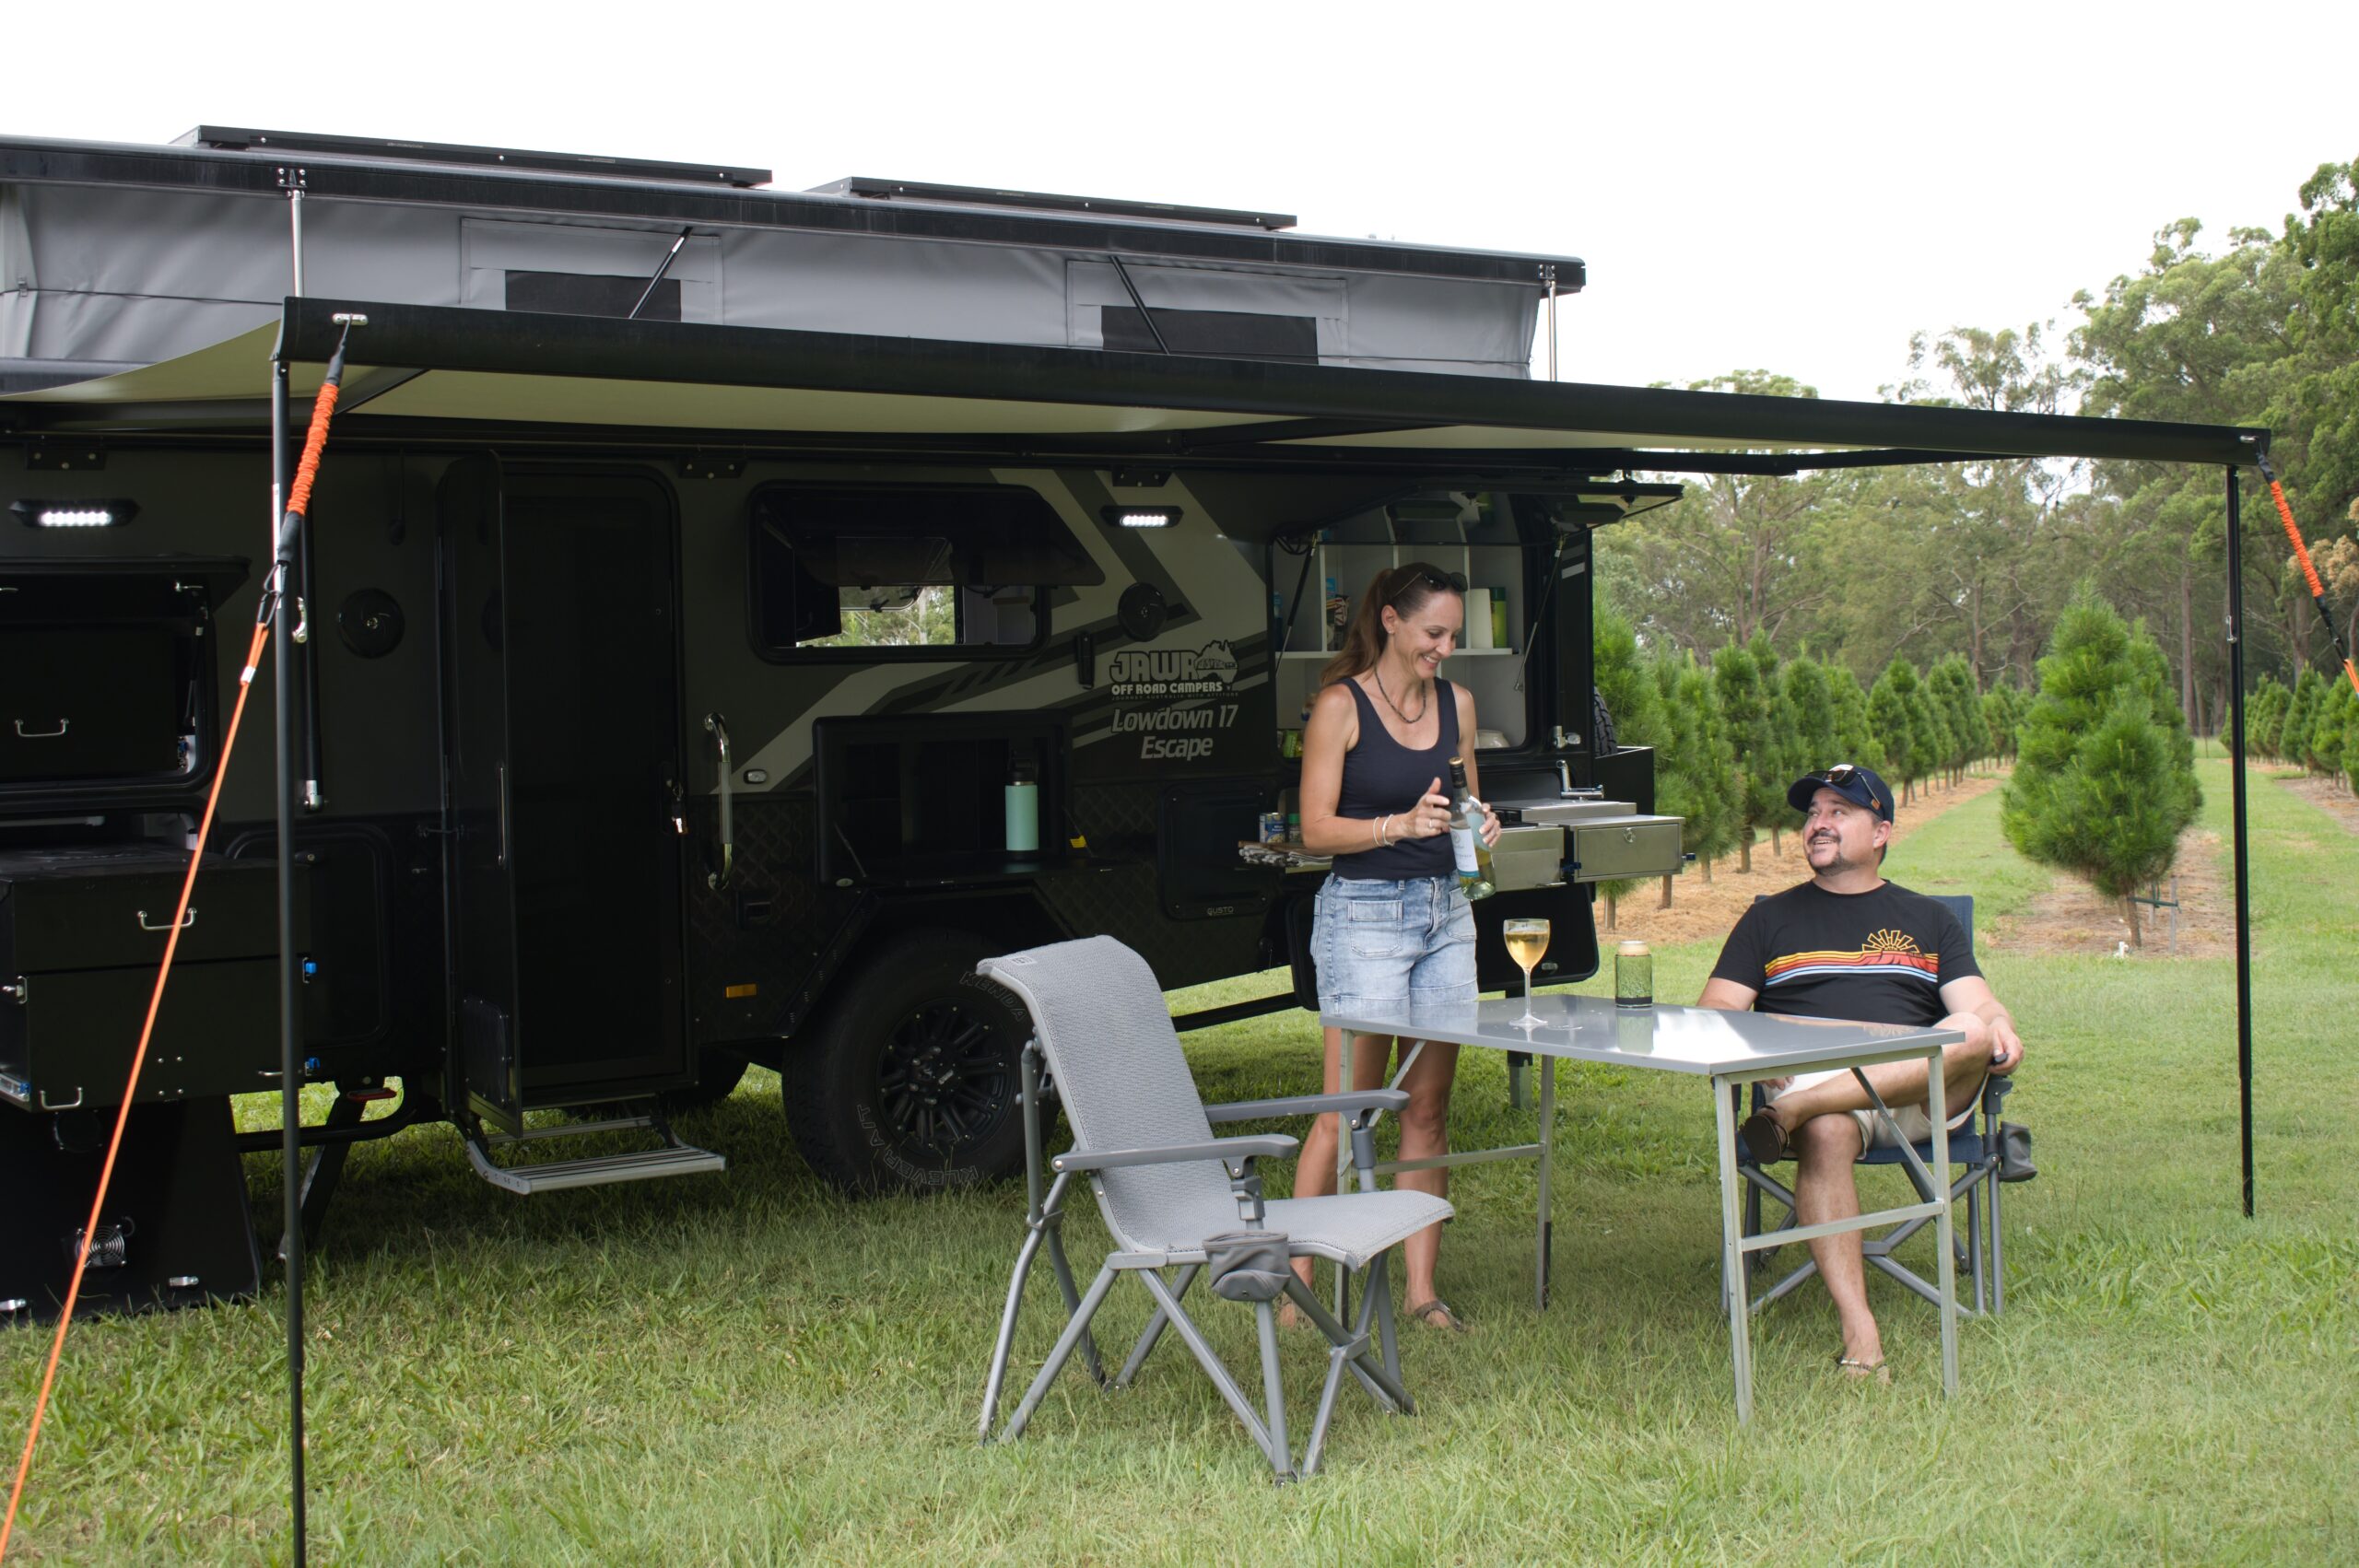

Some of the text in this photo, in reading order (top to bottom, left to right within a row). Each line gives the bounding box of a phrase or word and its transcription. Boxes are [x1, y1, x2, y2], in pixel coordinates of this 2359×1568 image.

[1111, 681, 1223, 696] OFF ROAD CAMPERS
[1111, 704, 1239, 732] Lowdown 17
[1140, 735, 1214, 761] Escape
[959, 971, 1027, 1022] KENDA
[856, 1104, 979, 1186] KLEVER A/T
